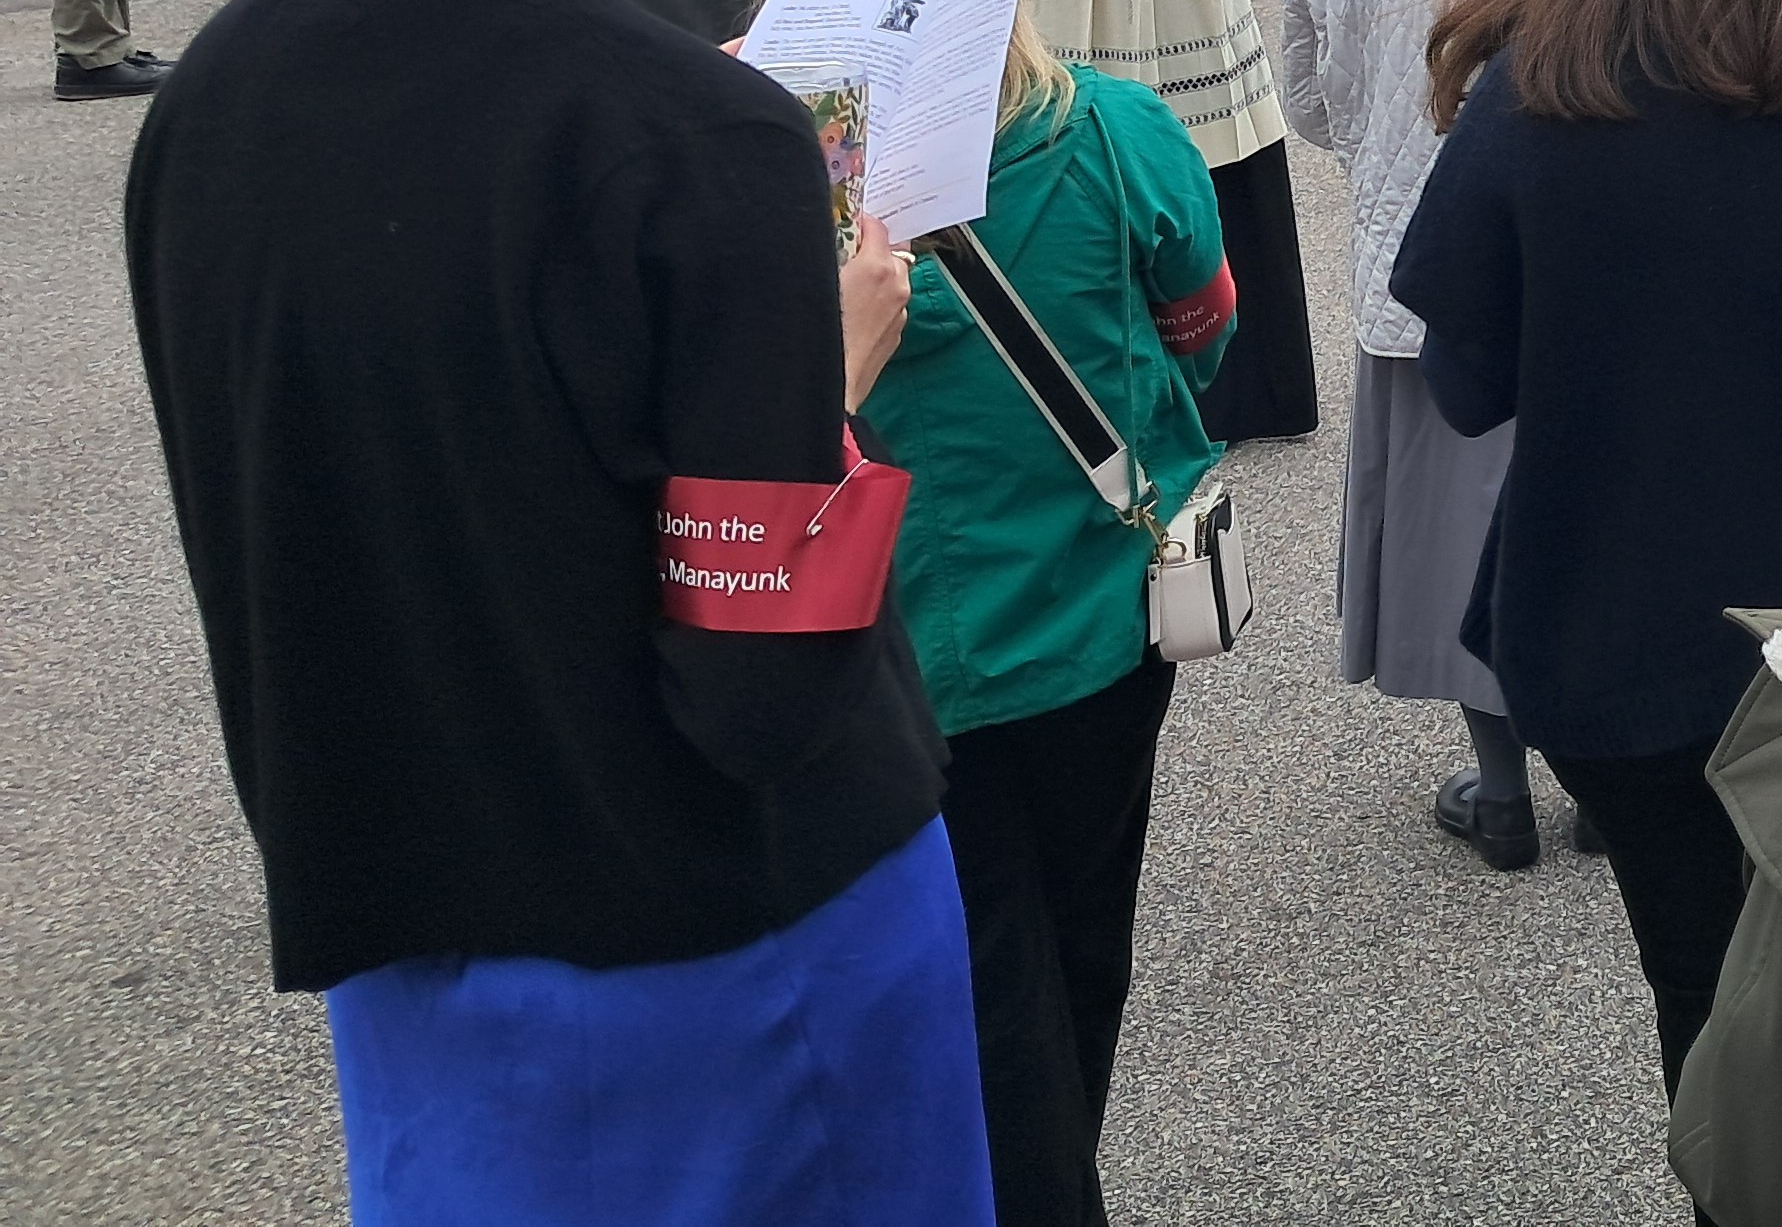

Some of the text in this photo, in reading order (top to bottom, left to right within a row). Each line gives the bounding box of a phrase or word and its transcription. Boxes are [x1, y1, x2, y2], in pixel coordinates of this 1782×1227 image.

[1154, 306, 1204, 326] hn the
[1161, 311, 1220, 342] anayunk
[663, 512, 712, 541] John
[719, 515, 766, 542] the
[668, 557, 792, 597] Manayunk
